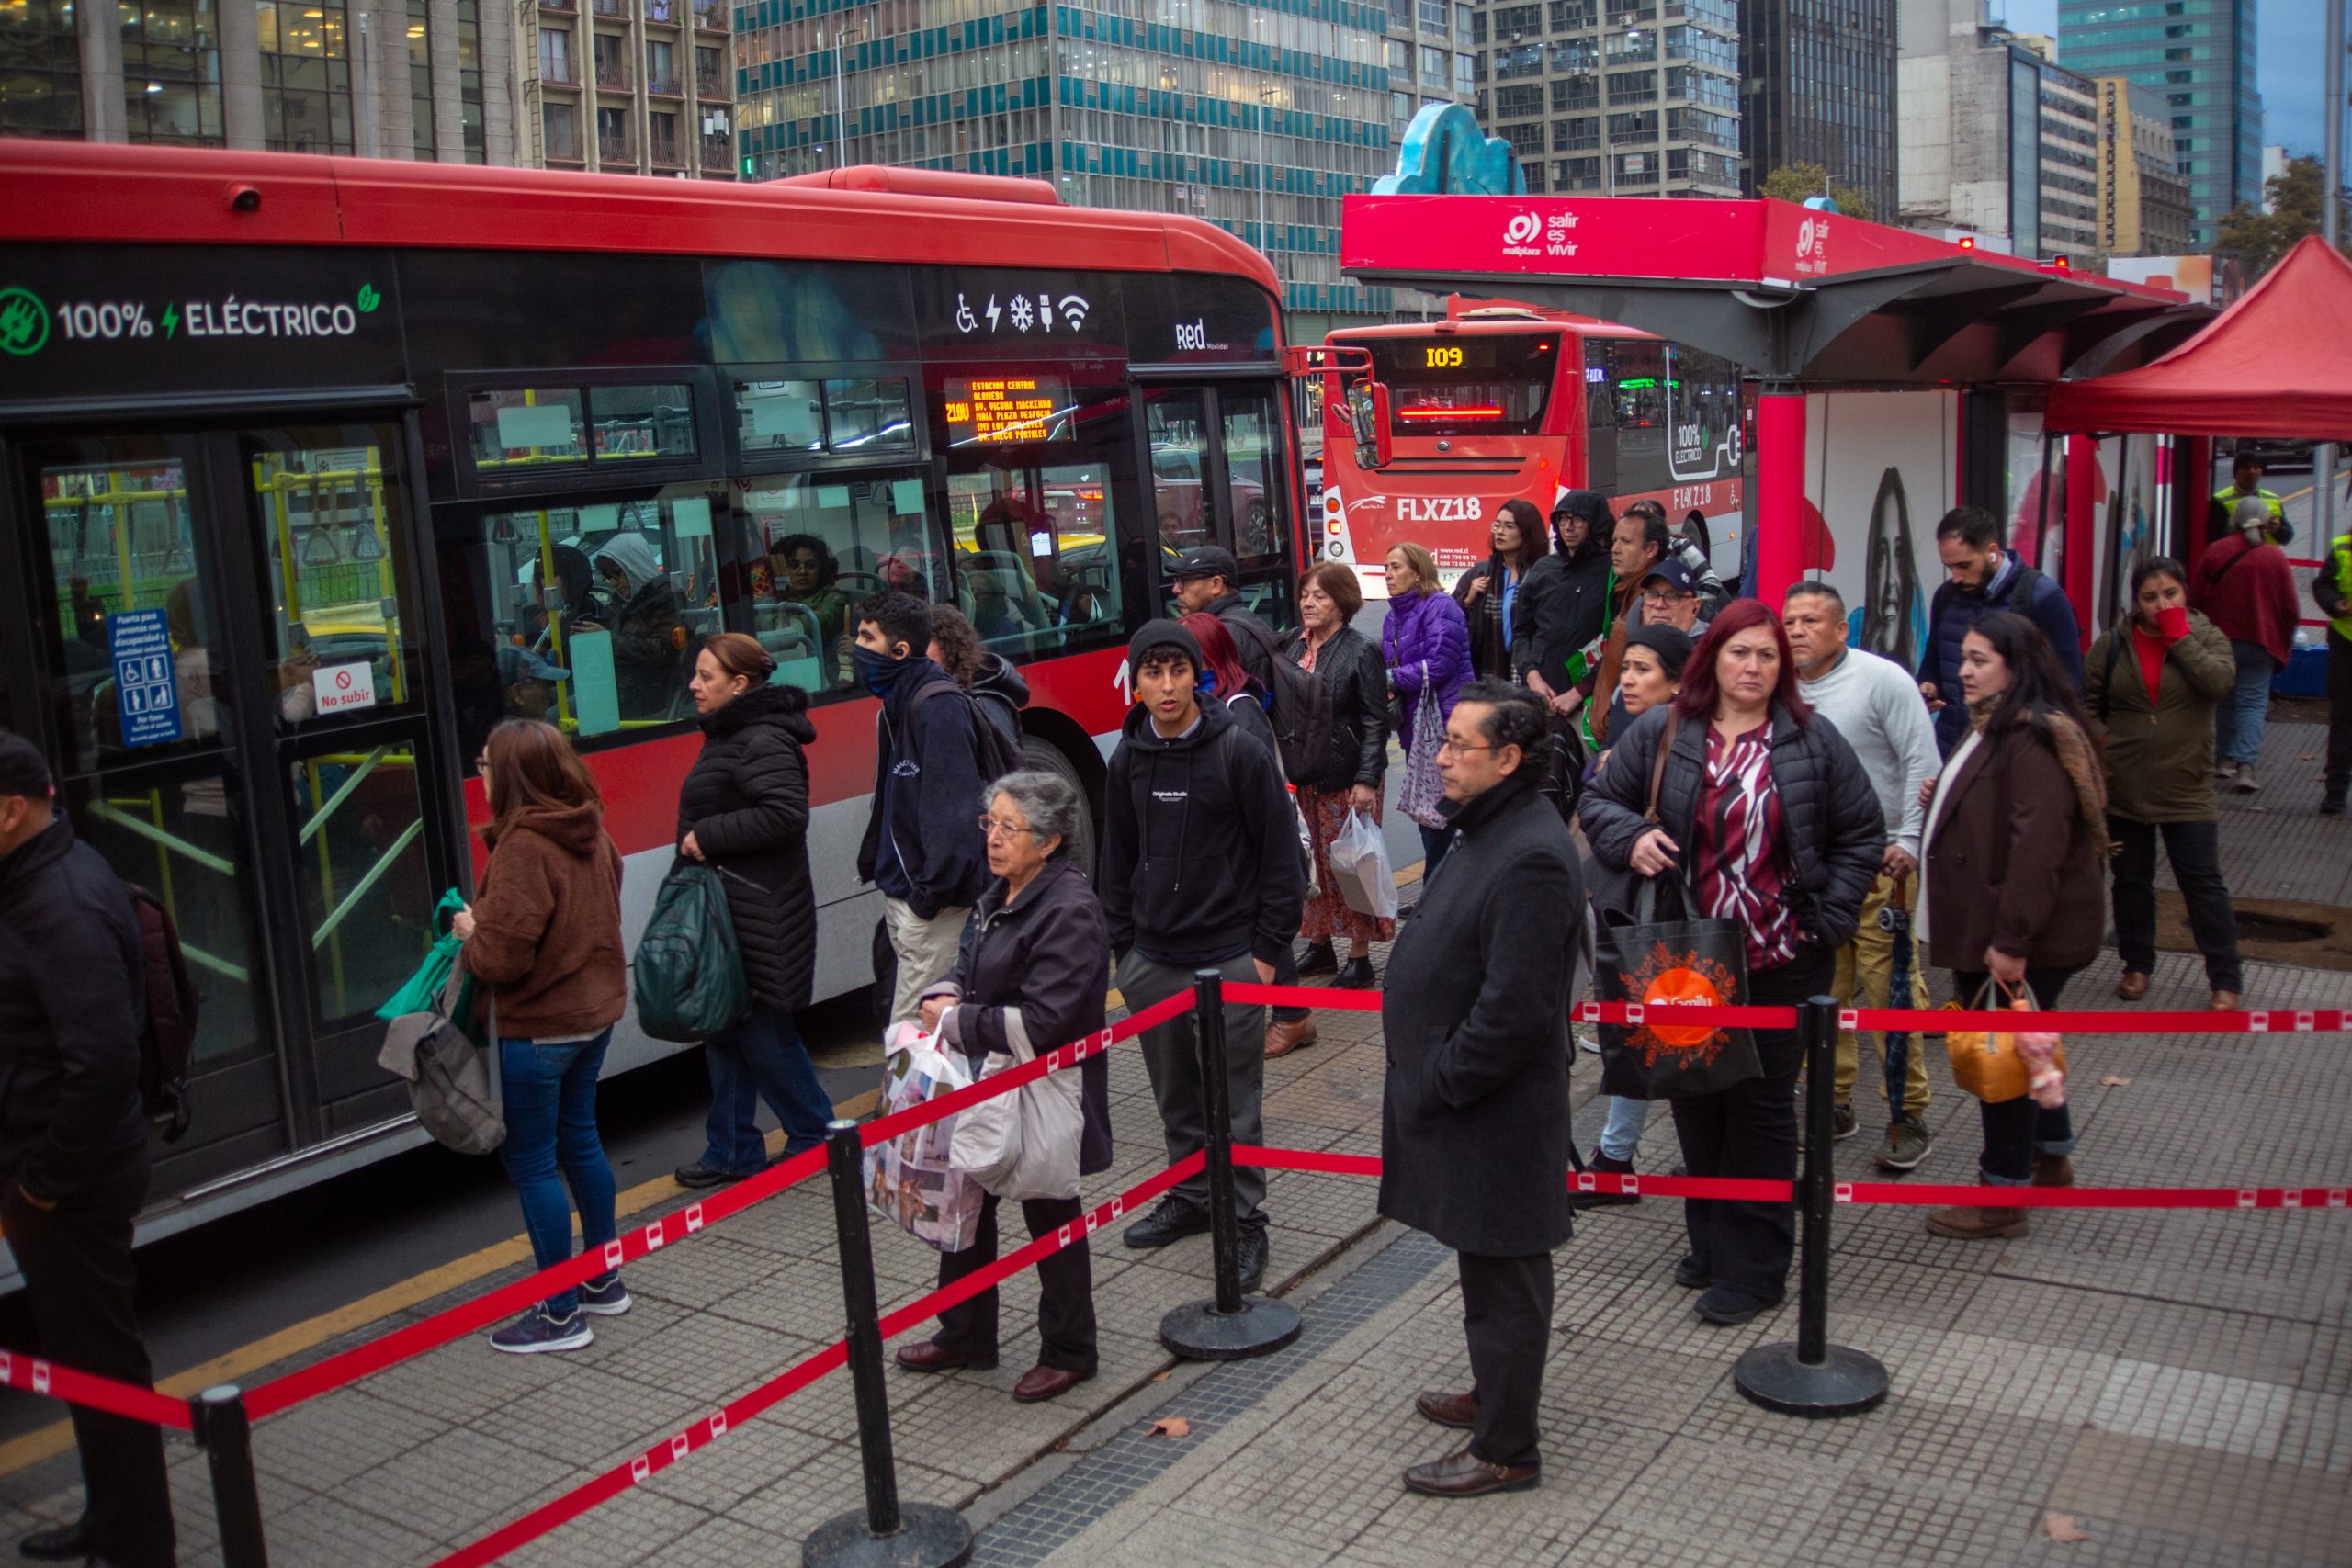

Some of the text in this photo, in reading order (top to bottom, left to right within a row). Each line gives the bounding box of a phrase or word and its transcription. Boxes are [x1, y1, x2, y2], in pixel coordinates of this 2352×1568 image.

[2106, 84, 2114, 247] HOTEL LIBERTADOR
[1548, 212, 1579, 228] salir
[1547, 229, 1566, 241] es
[1502, 246, 1542, 257] mallplaza
[1546, 241, 1578, 256] vivir
[58, 294, 356, 339] 100% ELÉCTRICO
[1176, 318, 1205, 350] Red
[972, 380, 1036, 391] ESTACION CENTRAL
[976, 412, 993, 422] MALL
[996, 411, 1018, 421] PLAZA
[991, 421, 1007, 431] LOS
[1678, 423, 1701, 448] 100%
[1397, 496, 1482, 522] FLXZ18
[117, 613, 157, 625] Puerta para
[116, 624, 162, 638] personas con
[322, 689, 370, 707] No subir
